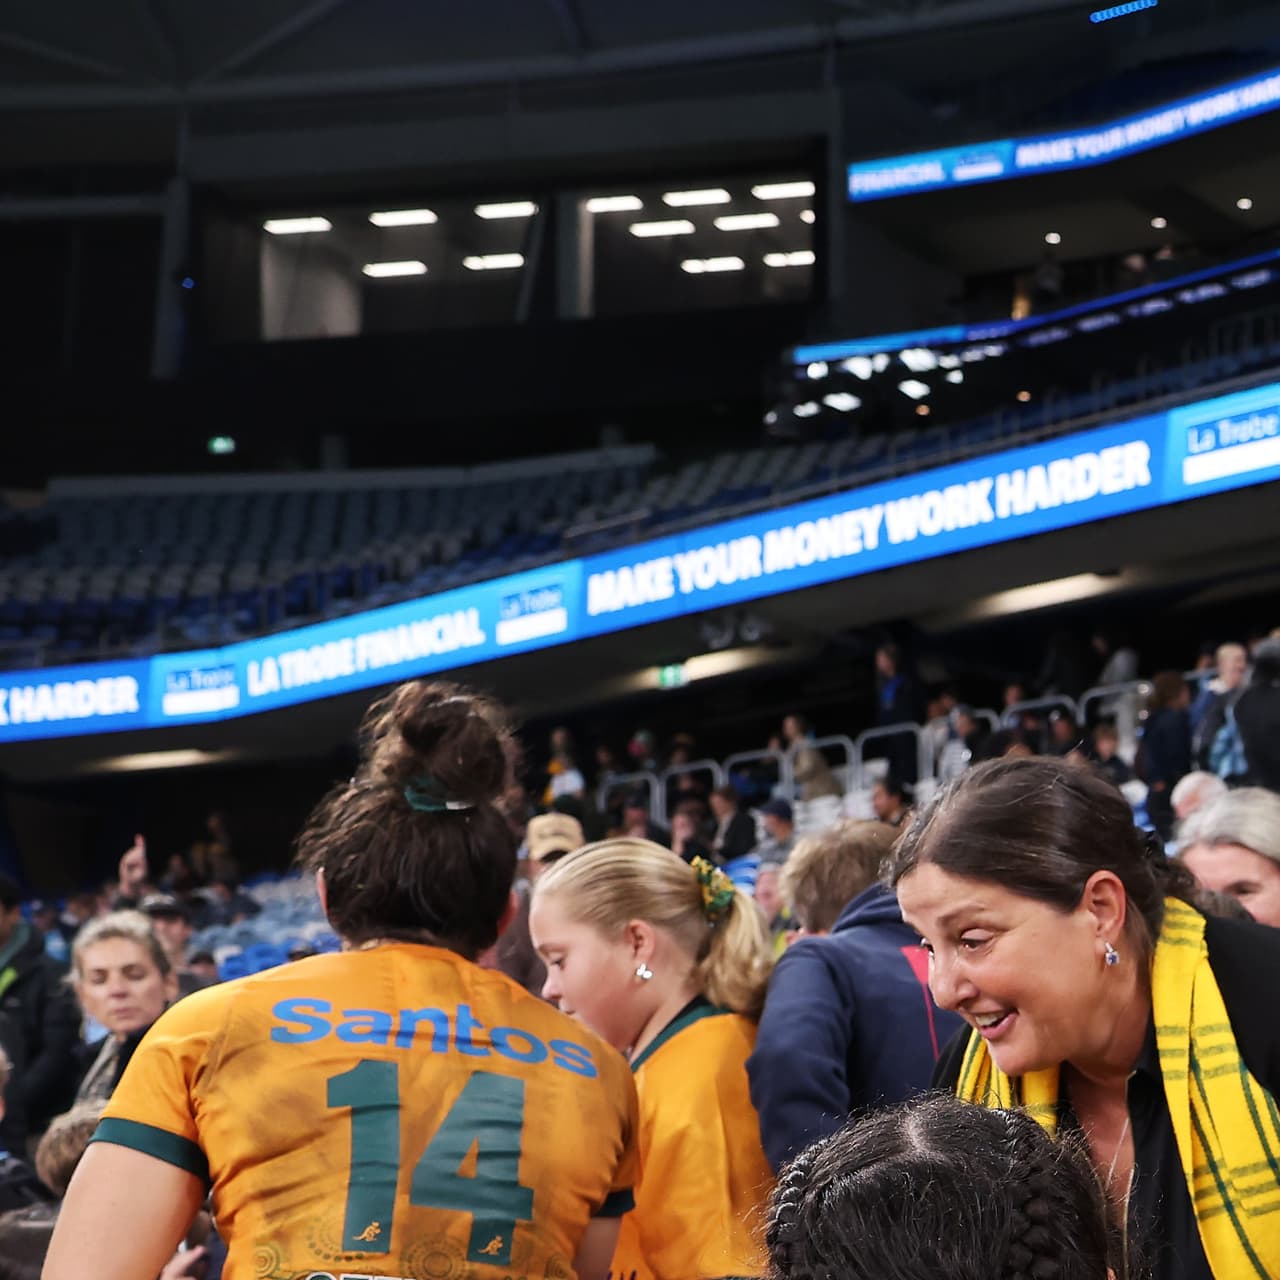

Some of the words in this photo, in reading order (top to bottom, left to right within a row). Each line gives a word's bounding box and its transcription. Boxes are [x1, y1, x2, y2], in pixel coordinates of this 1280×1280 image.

[587, 556, 675, 616] MAKE
[673, 535, 762, 594] YOUR
[763, 503, 884, 574] MONEY
[885, 478, 994, 544] WORK
[995, 440, 1151, 519] HARDER
[247, 656, 280, 697] LA
[279, 638, 355, 689] TROBE
[355, 607, 486, 673] FINANCIAL
[10, 675, 140, 724] HARDER
[270, 997, 597, 1079] Santos
[327, 1058, 535, 1266] 14
